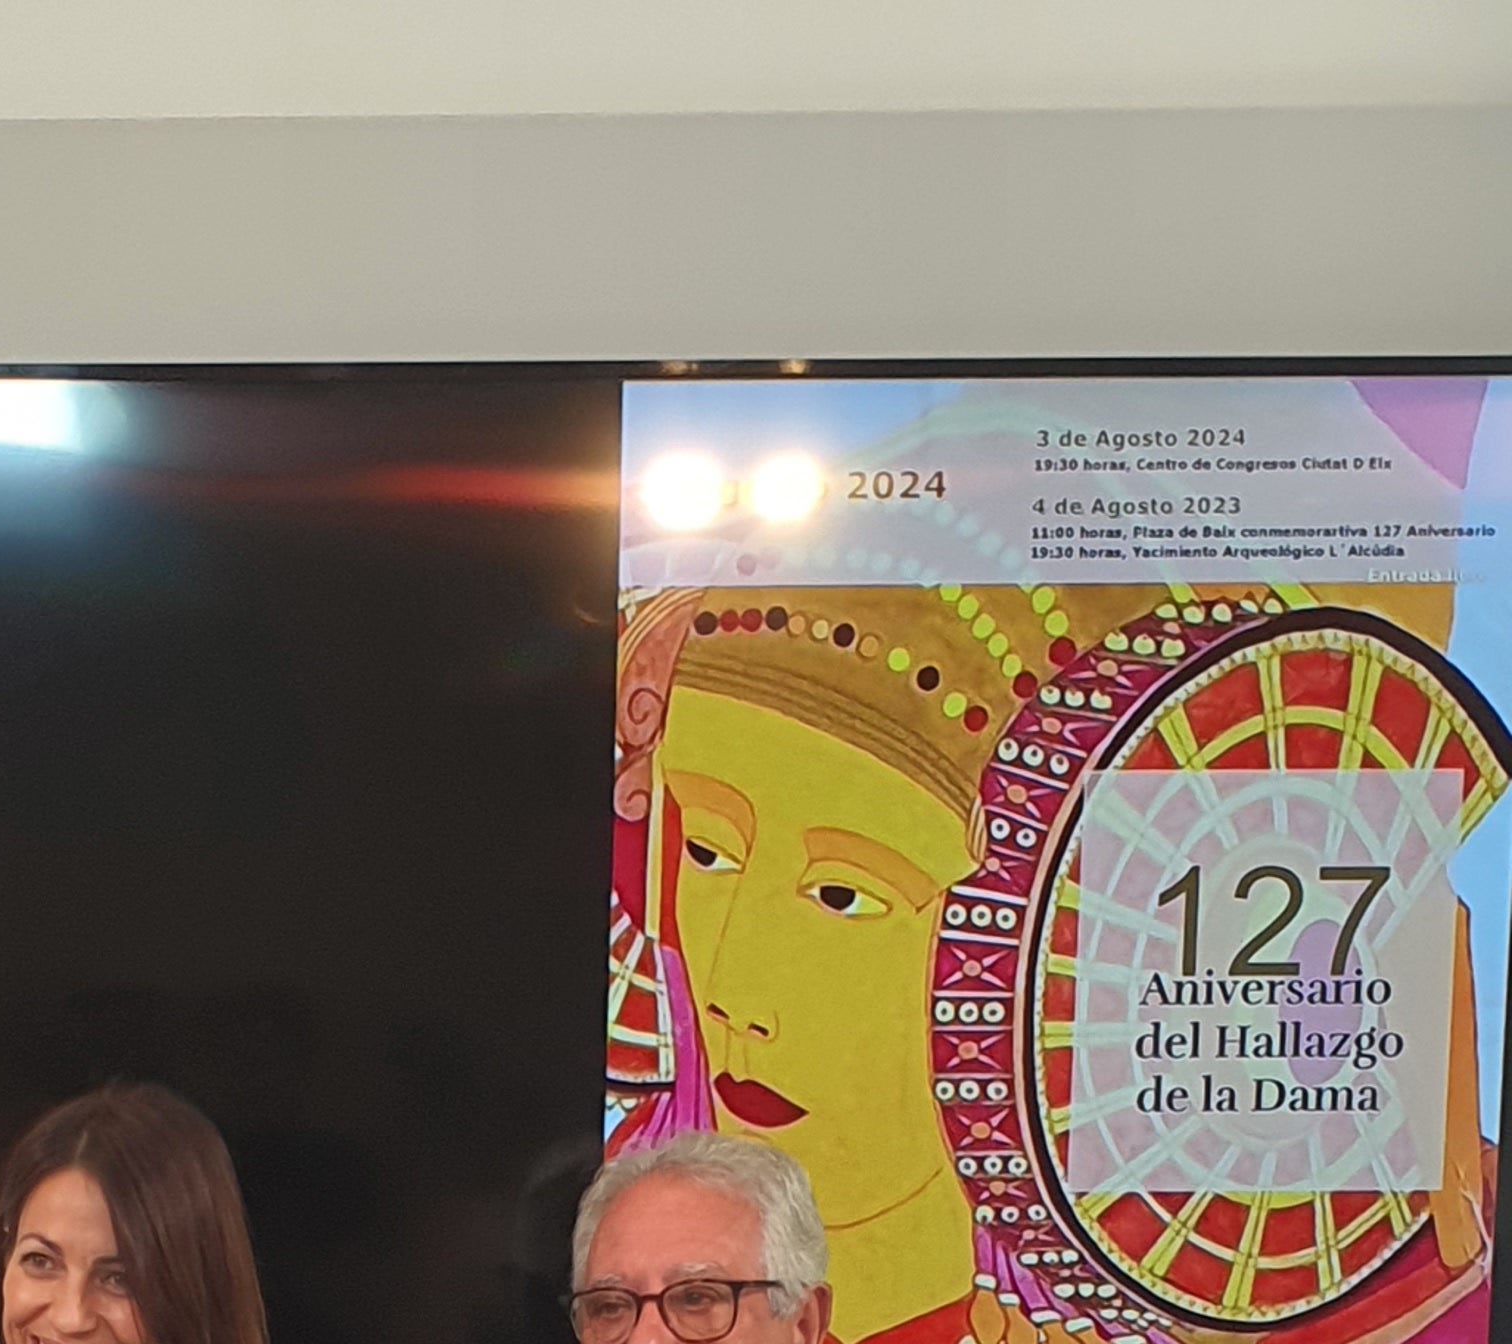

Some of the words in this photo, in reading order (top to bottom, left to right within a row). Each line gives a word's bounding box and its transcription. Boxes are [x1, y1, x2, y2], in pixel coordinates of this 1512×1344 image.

[1036, 430, 1049, 447] 3
[1059, 430, 1087, 447] de
[1096, 430, 1178, 451] Agosto
[1187, 429, 1245, 446] 2024
[1034, 459, 1078, 471] 19:30
[1083, 459, 1131, 472] horas,
[1137, 458, 1187, 471] Centro
[1192, 458, 1211, 470] de
[1216, 458, 1296, 473] Congresos
[1369, 457, 1392, 470] Elx
[848, 471, 947, 501] 2024
[1032, 498, 1045, 514] 4
[1054, 498, 1083, 514] de
[1091, 498, 1174, 518] Agosto
[1183, 497, 1241, 514] 2023
[1032, 526, 1075, 539] 11:00
[1079, 526, 1127, 540] horas,
[1133, 526, 1174, 539] Plaza
[1178, 526, 1198, 538] de
[1374, 525, 1401, 537] 127
[1406, 524, 1496, 538] Aniversario
[1031, 547, 1074, 559] 19:30
[1132, 545, 1218, 559] Yacimiento
[1222, 545, 1324, 560] Arqueológico
[1158, 865, 1391, 976] 127
[1139, 969, 1391, 1006] Aniversario
[1135, 1022, 1200, 1059] del
[1215, 1021, 1404, 1069] Hallazgo
[1136, 1076, 1189, 1112] de
[1202, 1075, 1237, 1112] la
[1251, 1078, 1379, 1112] Dama
